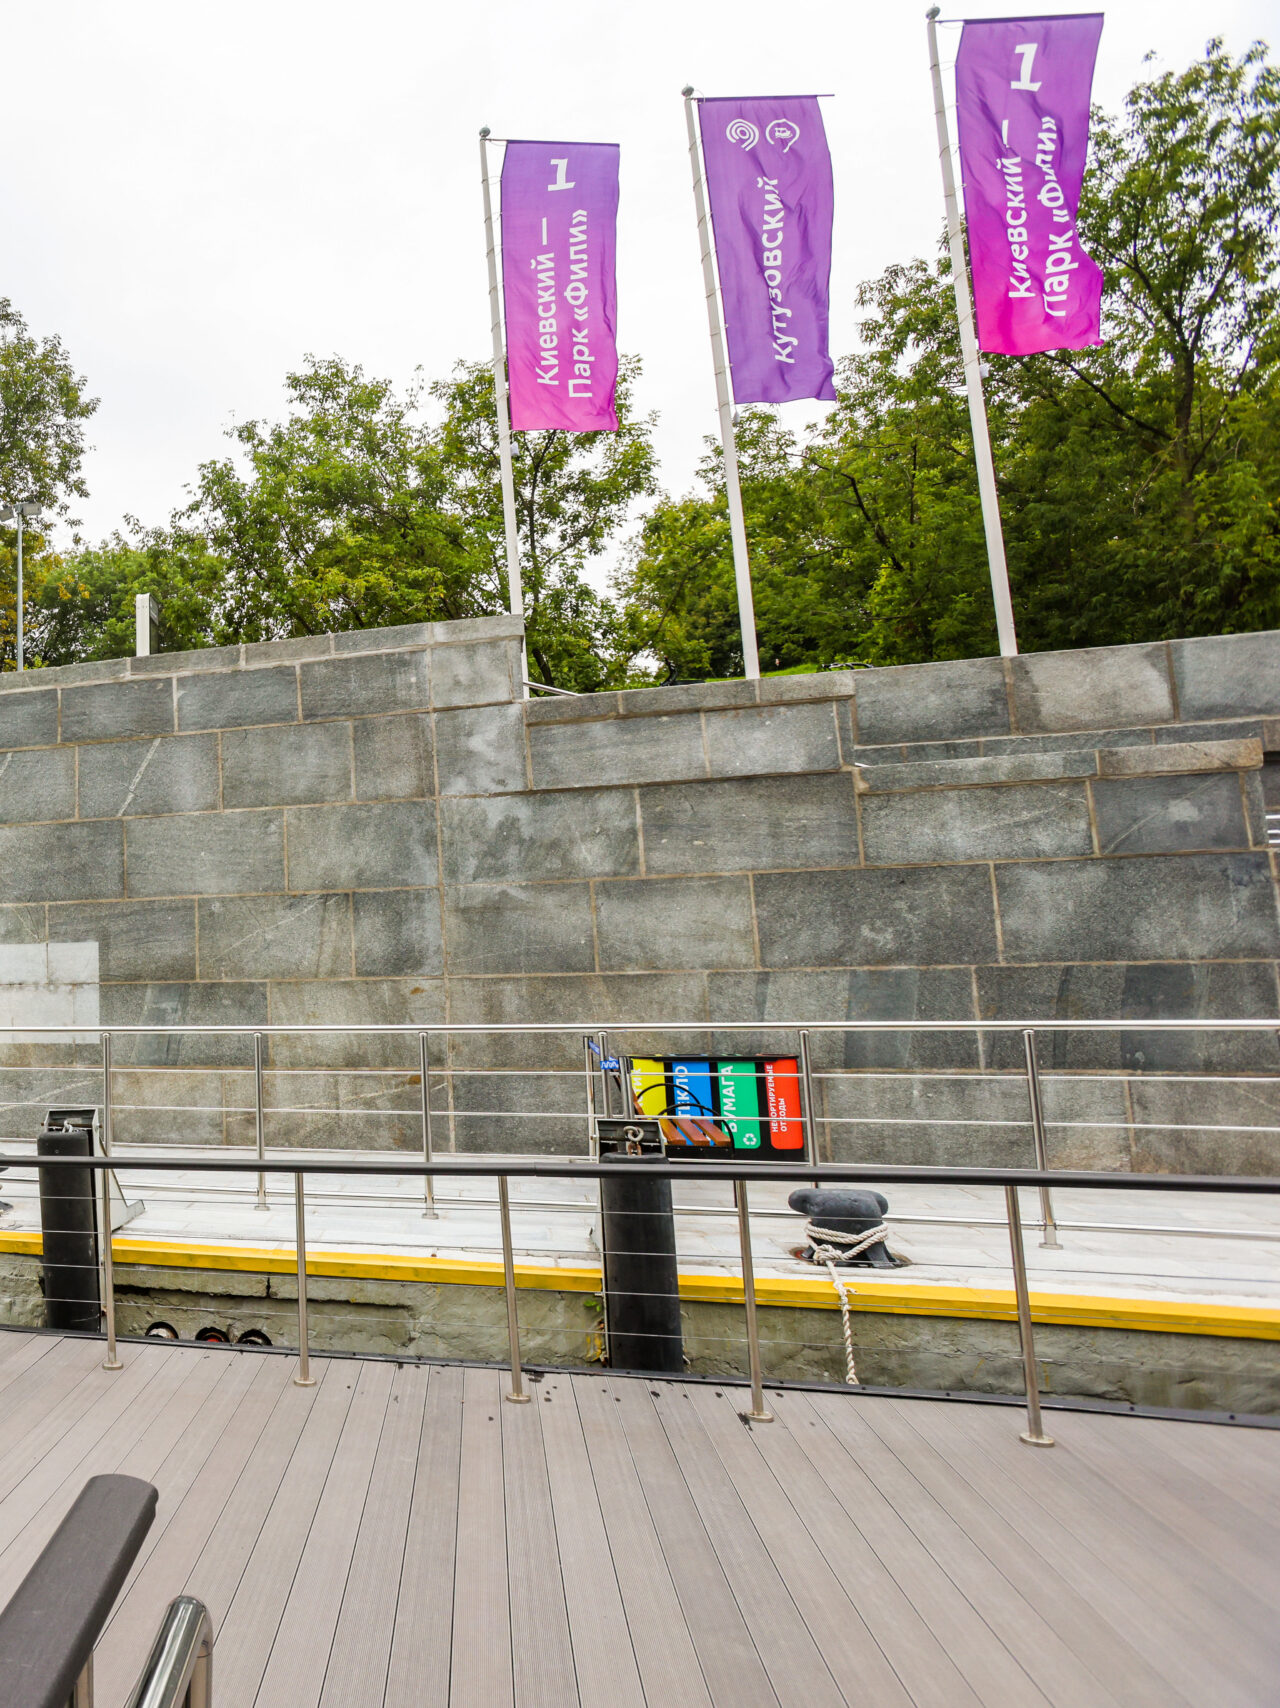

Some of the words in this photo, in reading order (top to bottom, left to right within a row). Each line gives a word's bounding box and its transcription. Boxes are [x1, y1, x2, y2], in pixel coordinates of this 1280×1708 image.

[1010, 42, 1042, 92] 1
[547, 158, 576, 192] 1
[1035, 115, 1069, 223] «Фили»
[563, 208, 589, 321] «Фили»
[756, 175, 798, 364] Кутузовский
[995, 155, 1036, 299] Киевский
[1042, 229, 1079, 318] Парк
[530, 252, 560, 386] Киевский
[567, 327, 595, 398] Парк
[674, 1065, 691, 1118] ТЕКЛО
[777, 1097, 788, 1132] ОТОДЫ
